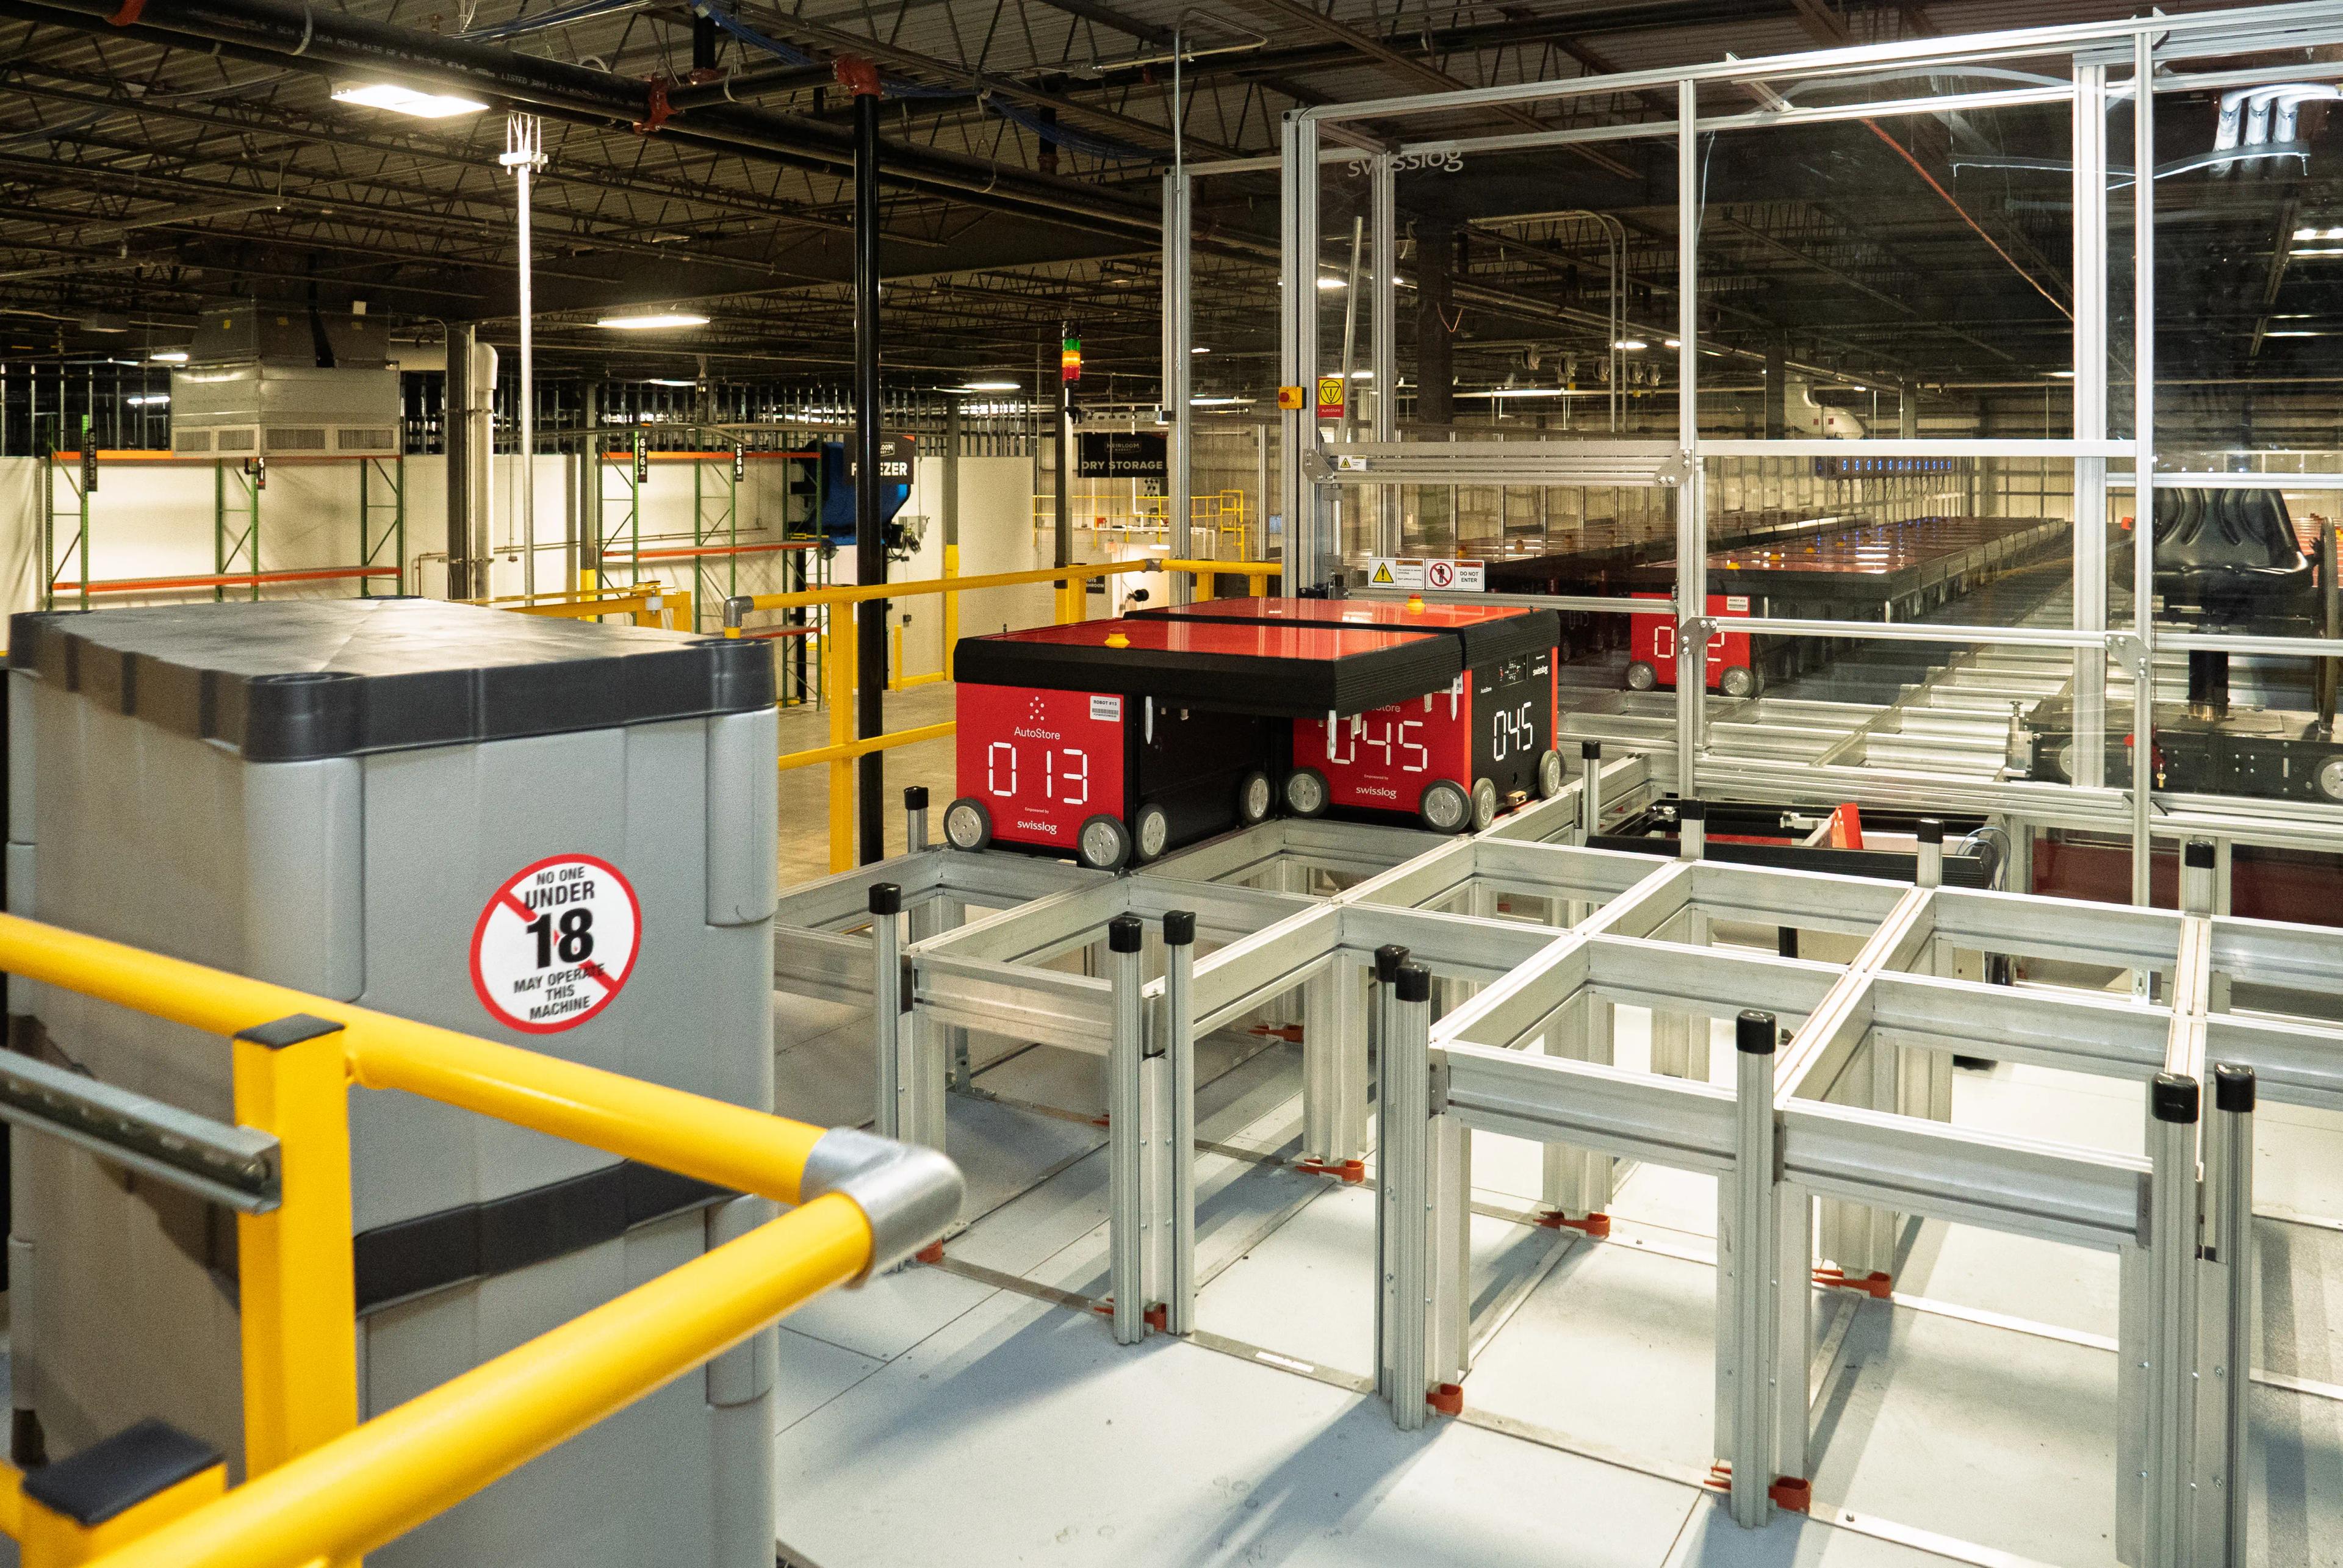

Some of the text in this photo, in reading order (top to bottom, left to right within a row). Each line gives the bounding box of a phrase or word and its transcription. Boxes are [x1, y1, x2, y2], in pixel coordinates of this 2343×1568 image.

[315, 34, 333, 44] USA
[337, 38, 358, 49] ASTM
[501, 73, 527, 84] LISTED
[851, 462, 908, 476] FZER
[1082, 461, 1163, 470] DRY STORAGE
[1654, 625, 1725, 663] 02
[1013, 726, 1060, 740] AutoStore
[1494, 701, 1533, 761] 045
[988, 741, 1088, 805] 013
[1356, 786, 1397, 800] swisslog
[1017, 820, 1057, 835] swisslog
[536, 866, 585, 886] NO ONE
[524, 880, 595, 911] UNDER
[526, 907, 594, 970] 18
[513, 963, 605, 993] MAY OPERATE
[545, 984, 575, 1002] THIS
[528, 995, 591, 1021] MACHINE
